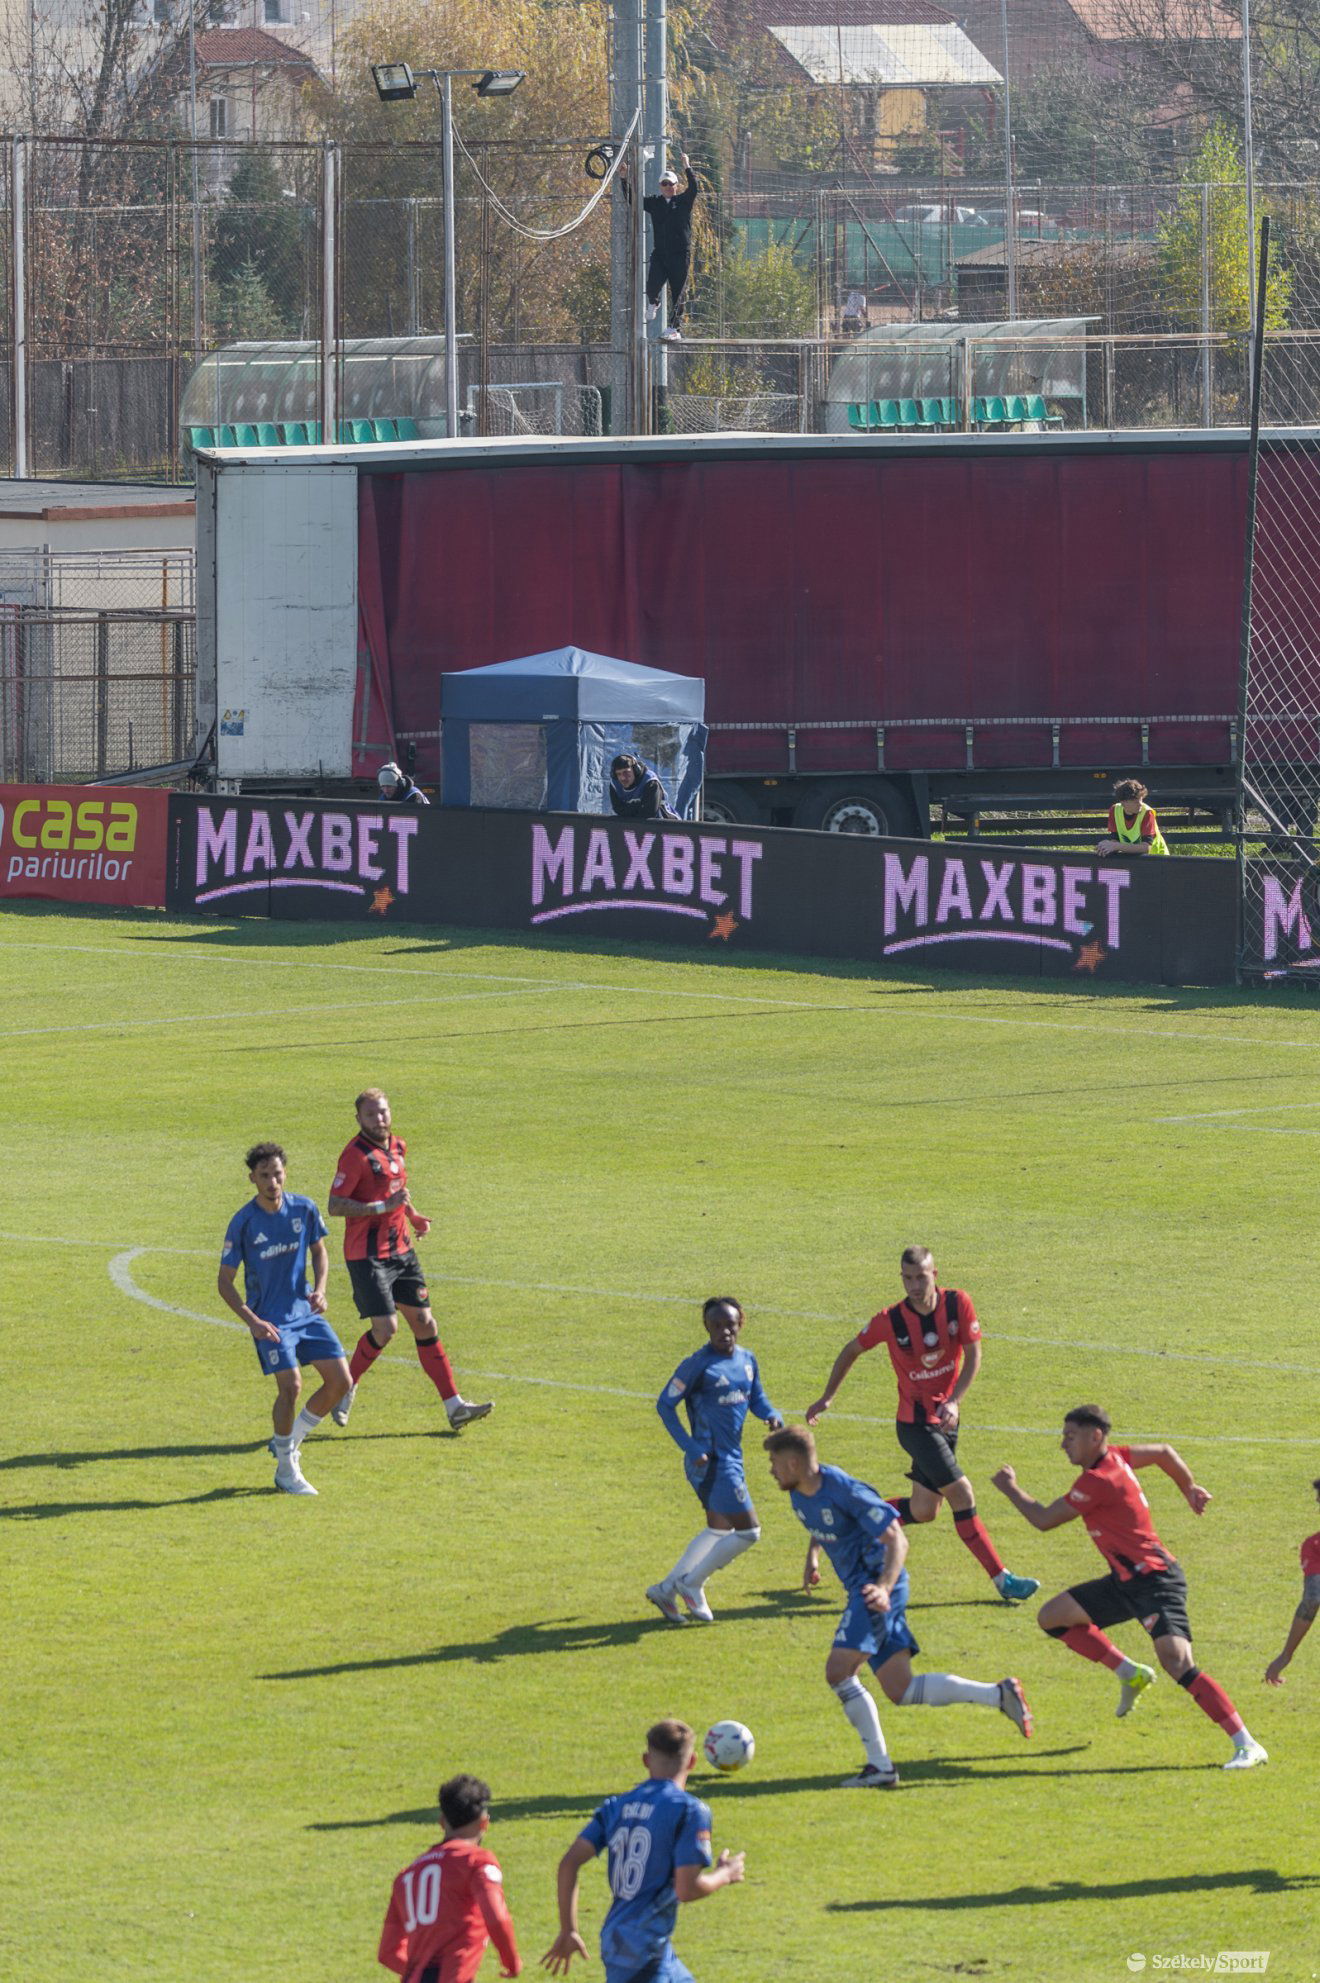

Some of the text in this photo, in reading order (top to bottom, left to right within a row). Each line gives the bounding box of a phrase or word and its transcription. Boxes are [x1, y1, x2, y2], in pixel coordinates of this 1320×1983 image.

[12, 799, 138, 852] casa
[195, 806, 419, 895] MAXBET
[7, 851, 133, 883] pariurilor
[531, 823, 763, 920] MAXBET
[883, 852, 1131, 950] MAXBET
[403, 1862, 442, 1933] 10
[608, 1825, 652, 1901] 18
